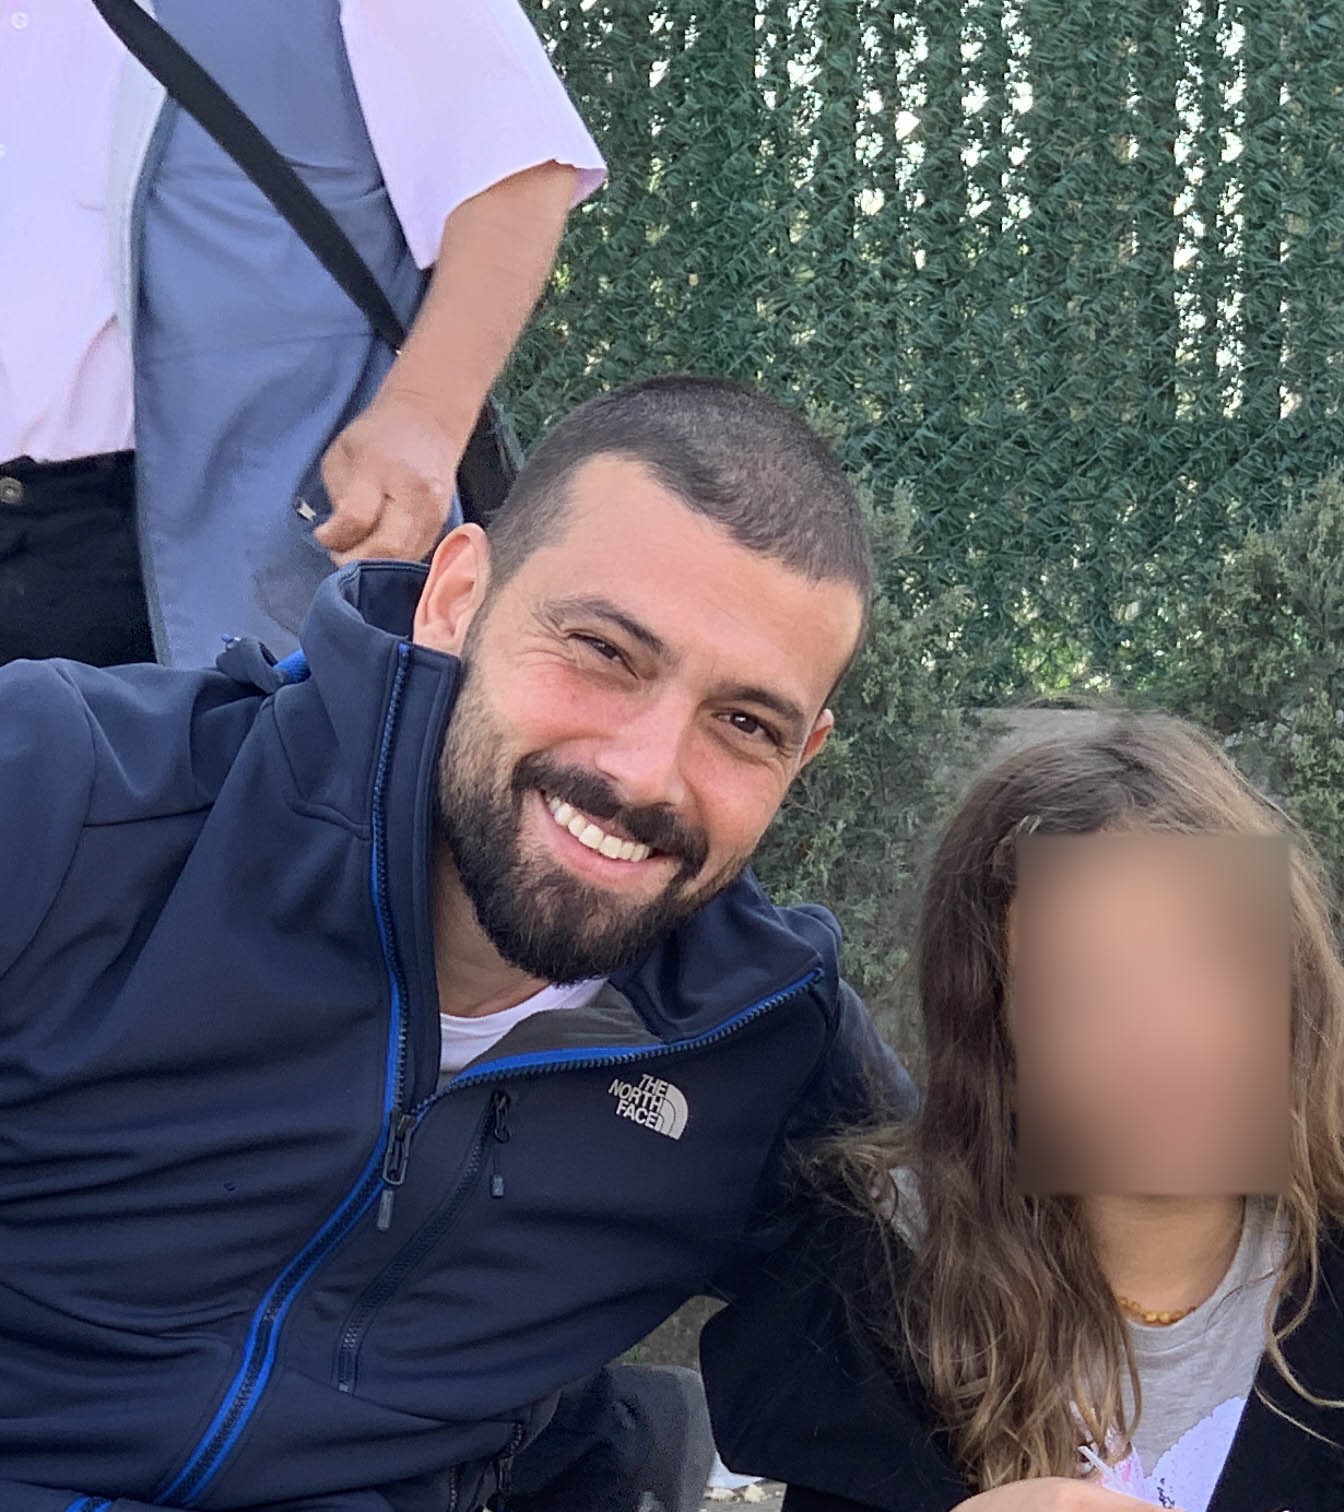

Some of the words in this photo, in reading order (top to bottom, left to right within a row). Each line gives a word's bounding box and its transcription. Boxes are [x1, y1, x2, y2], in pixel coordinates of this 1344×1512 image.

[608, 1079, 664, 1112] NORTH
[639, 1073, 669, 1098] THE
[616, 1100, 657, 1129] FACE
